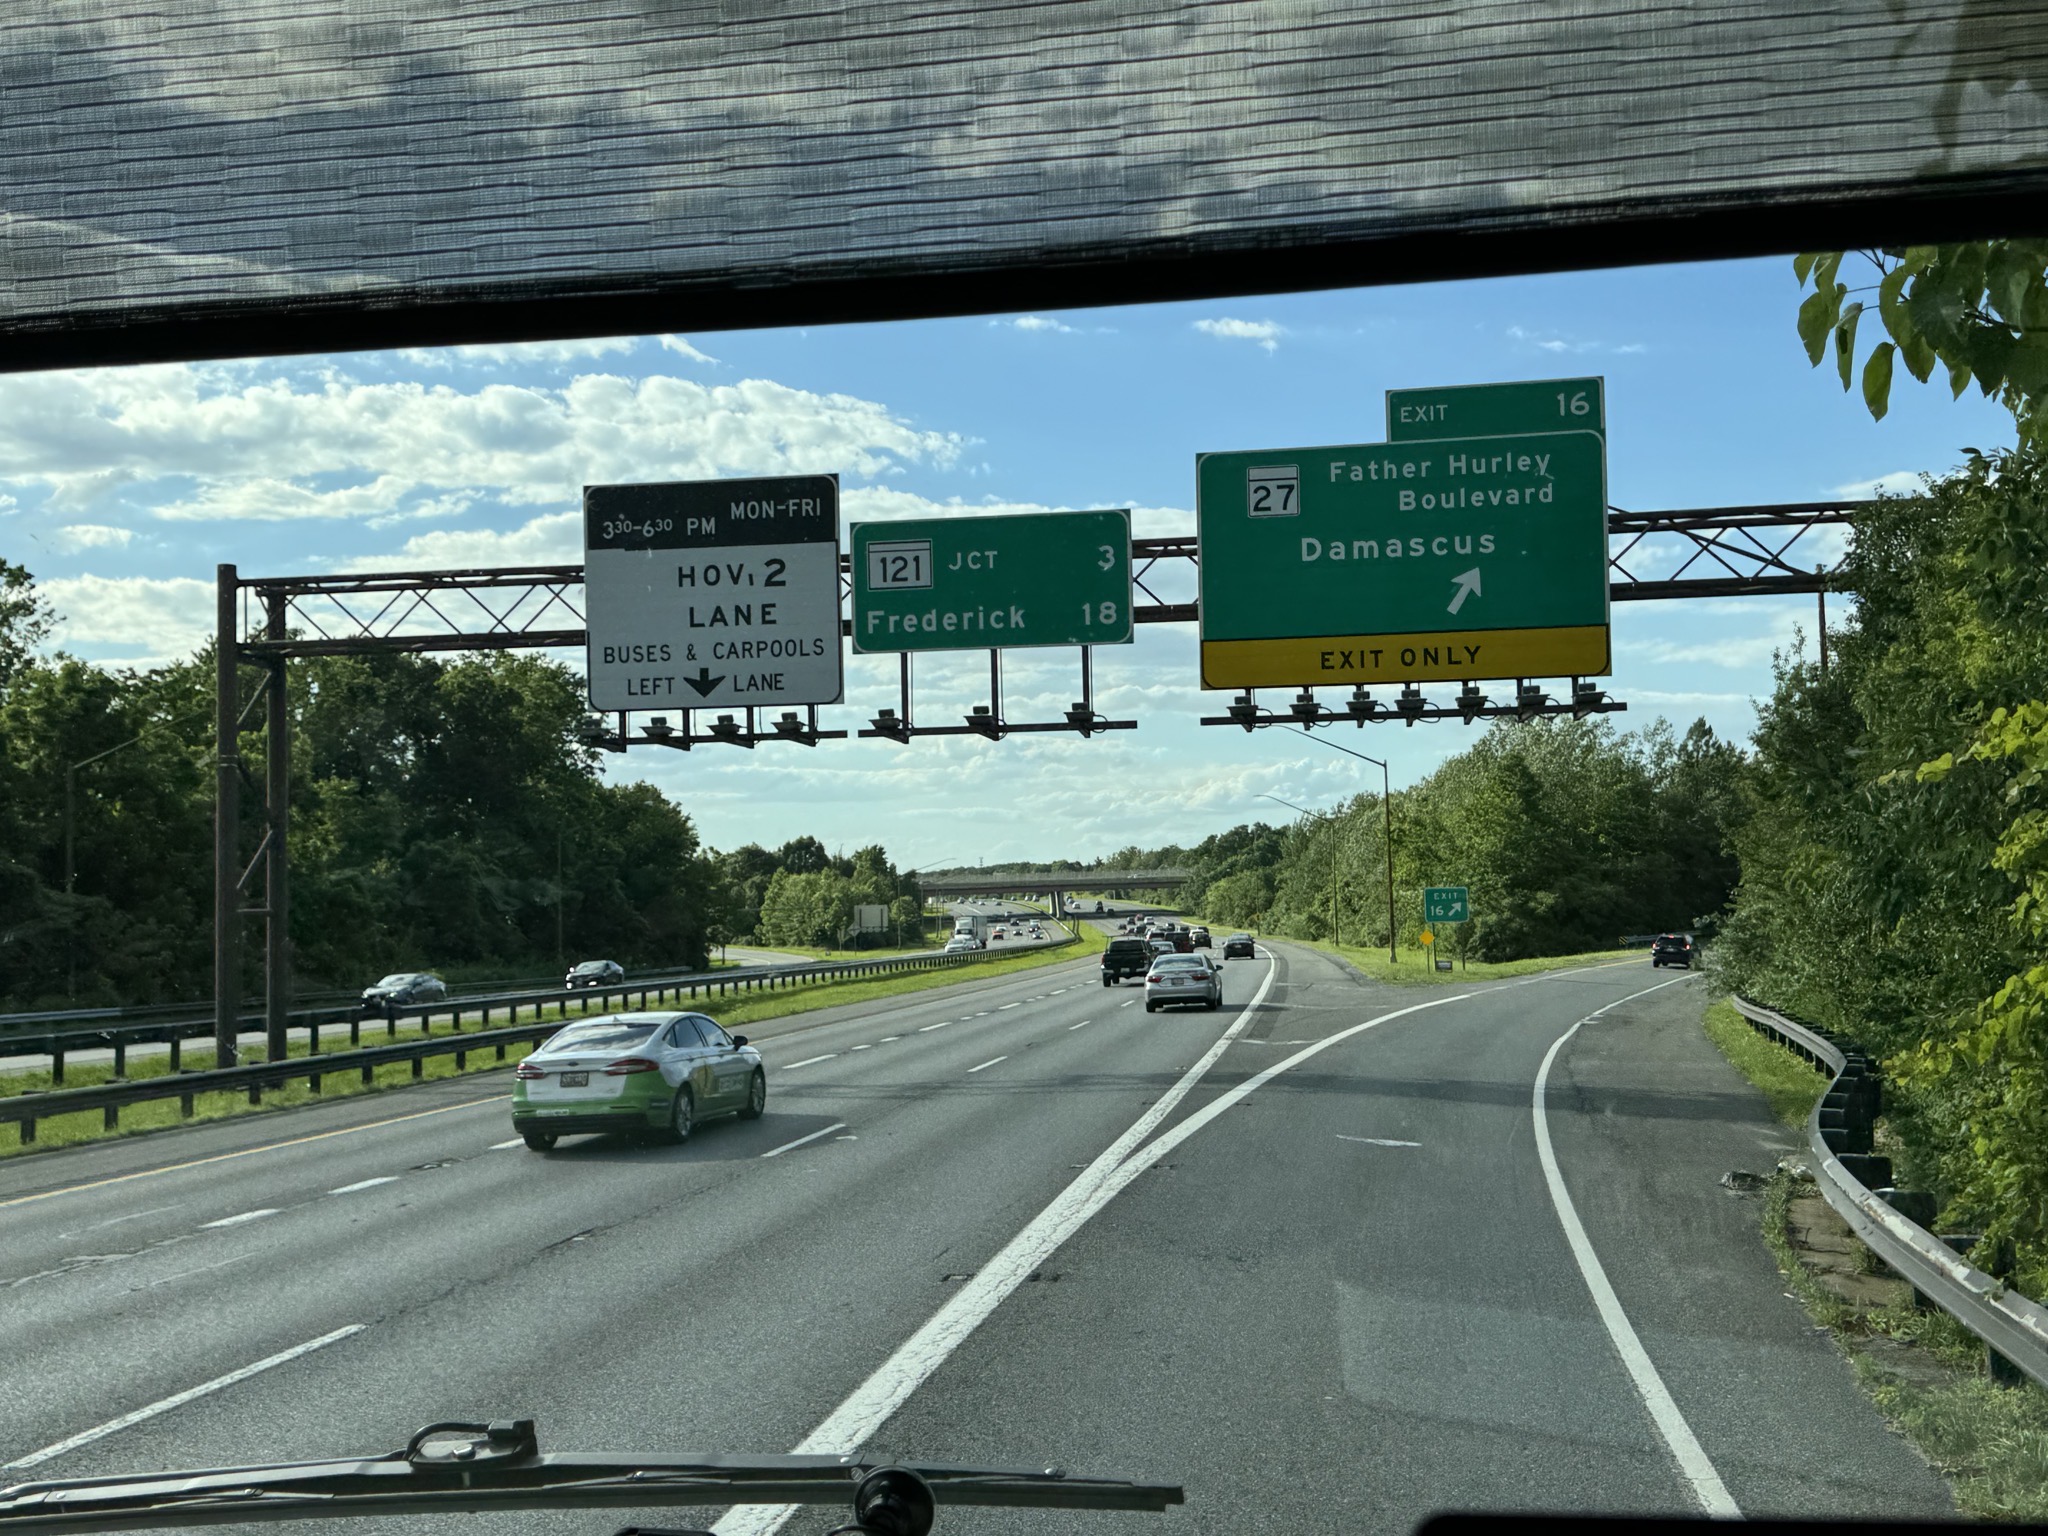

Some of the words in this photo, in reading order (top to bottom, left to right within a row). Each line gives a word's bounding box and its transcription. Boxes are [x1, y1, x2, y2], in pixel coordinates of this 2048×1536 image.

[1400, 404, 1448, 422] EXIT
[1557, 391, 1590, 416] 16
[1330, 459, 1431, 482] Father
[1448, 453, 1551, 477] Hurley
[1252, 484, 1296, 512] 27
[1399, 483, 1553, 511] Boulevard
[687, 517, 716, 536] PM
[730, 498, 821, 520] MON-FRI
[949, 550, 998, 570] JCT
[1097, 545, 1116, 571] 3
[1301, 533, 1496, 562] Damascus
[764, 558, 786, 587] 2
[879, 555, 920, 583] 121
[689, 603, 777, 628] LANE
[867, 605, 1026, 634] Frederick
[1082, 601, 1118, 626] 18
[603, 644, 671, 664] BUSES
[687, 644, 697, 661] &
[713, 638, 825, 660] CARPOOLS
[1320, 649, 1384, 670] EXIT
[1401, 645, 1482, 667] ONLY
[627, 677, 675, 696] LEFT
[733, 673, 785, 692] LANE
[1433, 892, 1458, 900] EXIT
[1430, 905, 1444, 916] 16
